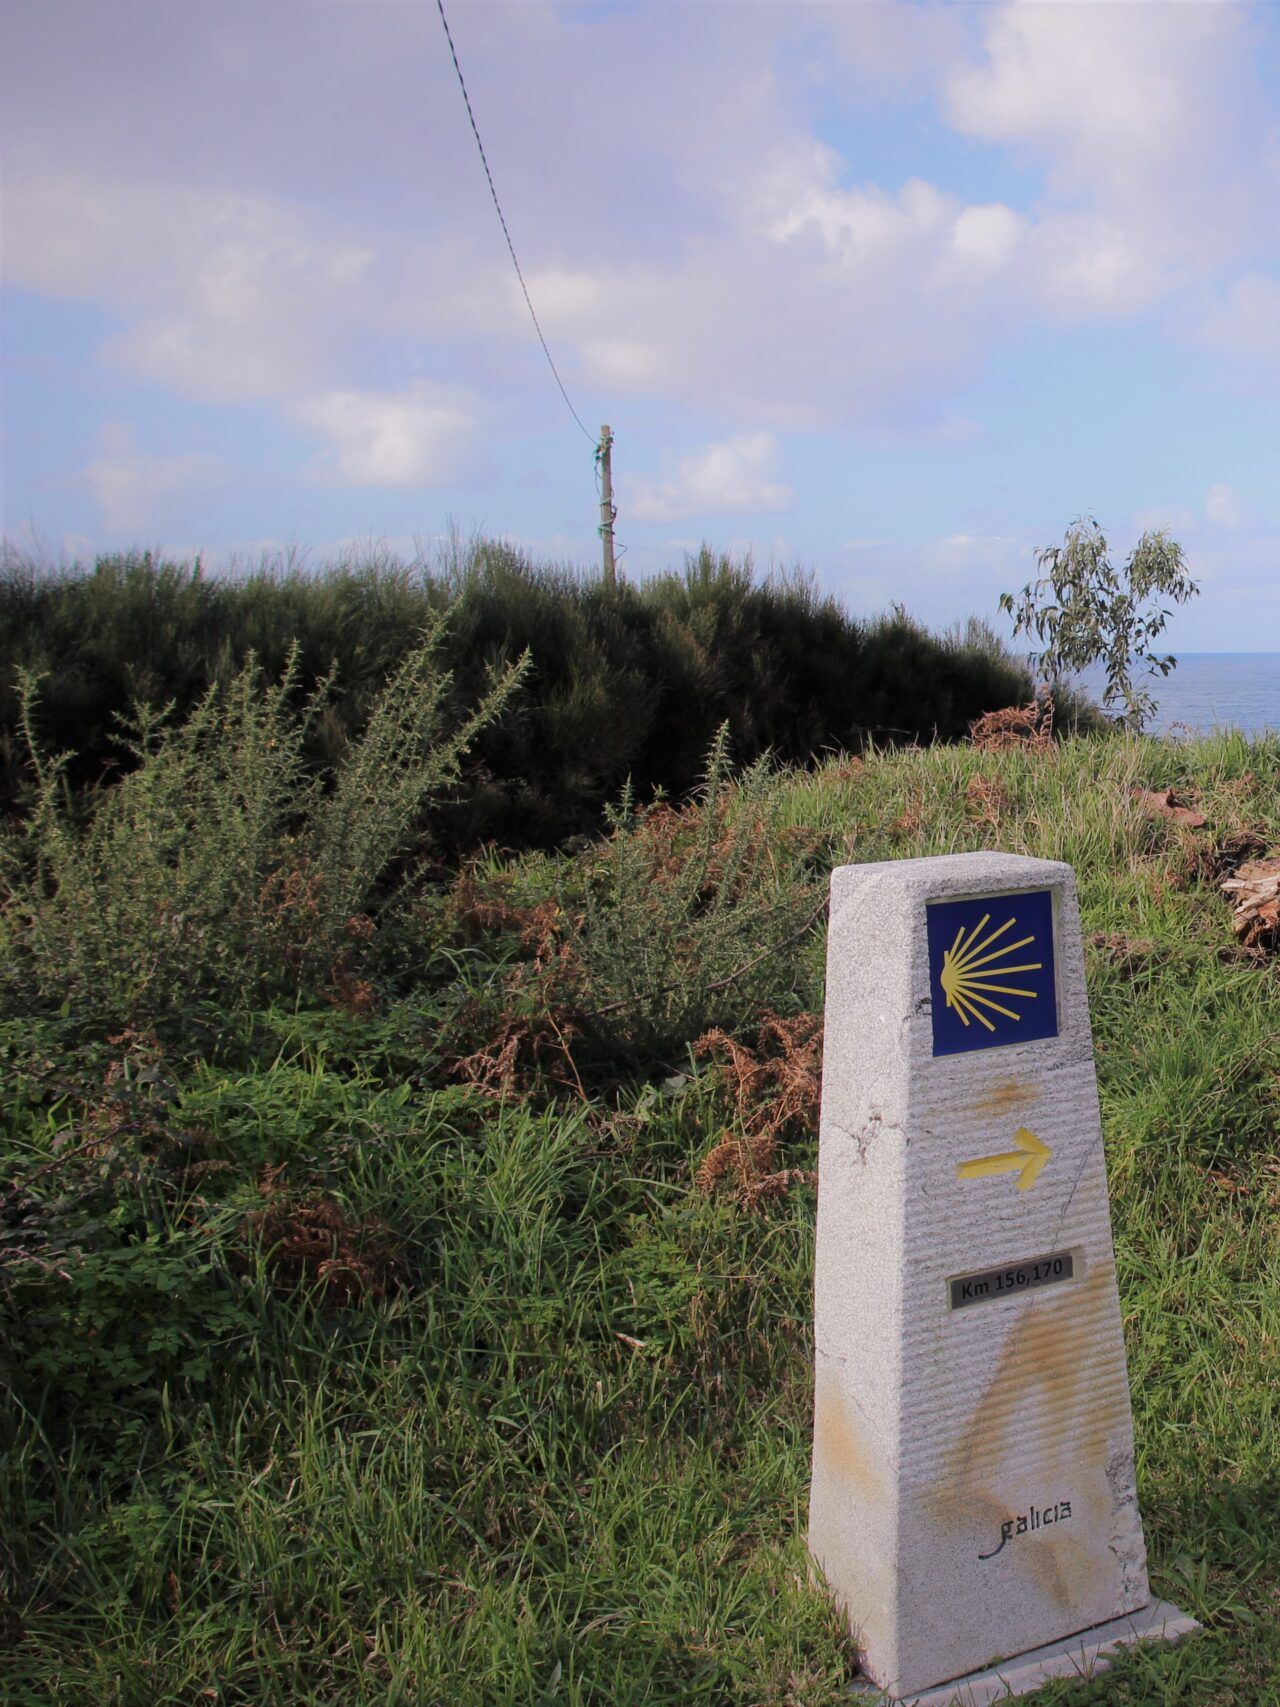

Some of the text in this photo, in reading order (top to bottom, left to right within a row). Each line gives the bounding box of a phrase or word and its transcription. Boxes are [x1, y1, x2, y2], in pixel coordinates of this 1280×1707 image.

[961, 1259, 1063, 1300] Km 156,170
[978, 1501, 1072, 1560] galicia
